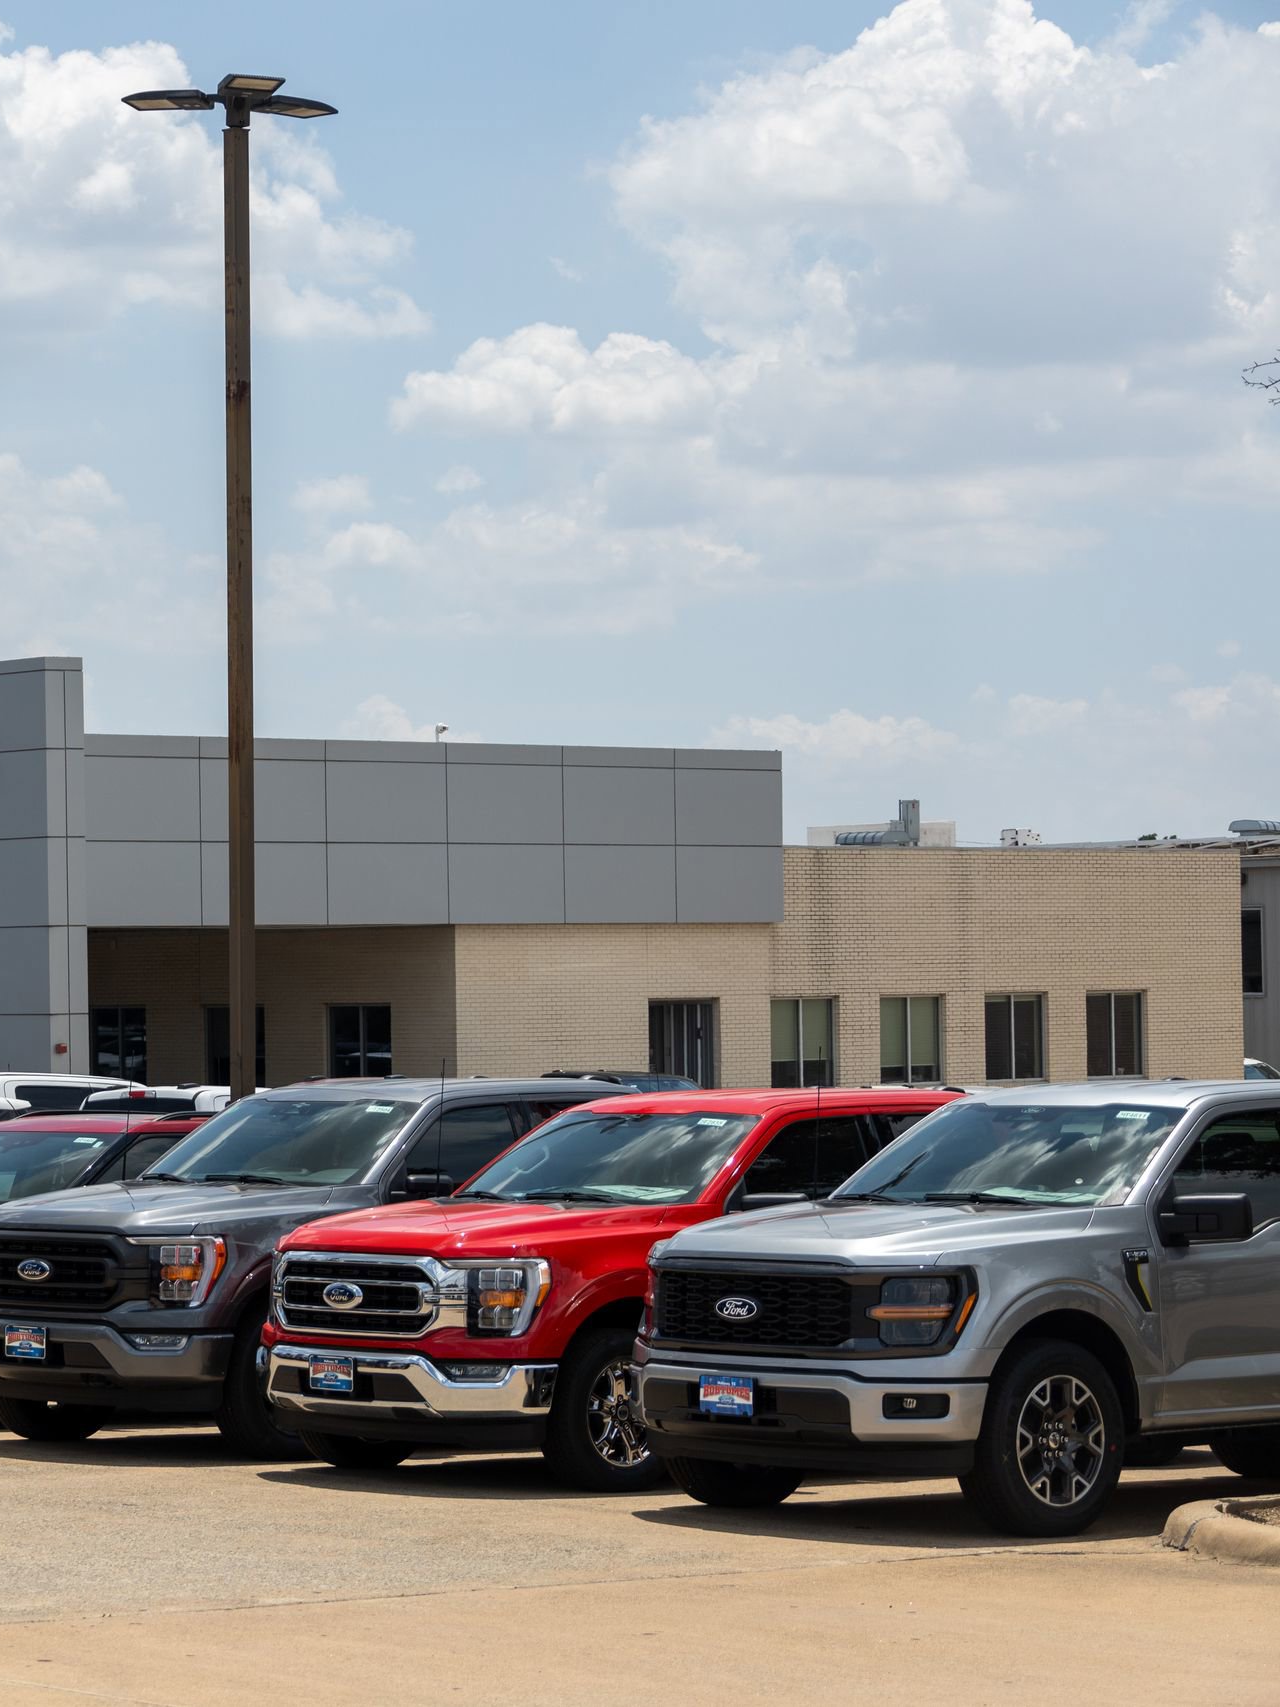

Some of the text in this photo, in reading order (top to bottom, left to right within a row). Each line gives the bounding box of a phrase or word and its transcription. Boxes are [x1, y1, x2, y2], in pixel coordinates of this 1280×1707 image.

[23, 1264, 41, 1275] Ford
[330, 1289, 350, 1300] Ford
[723, 1300, 749, 1316] Ford
